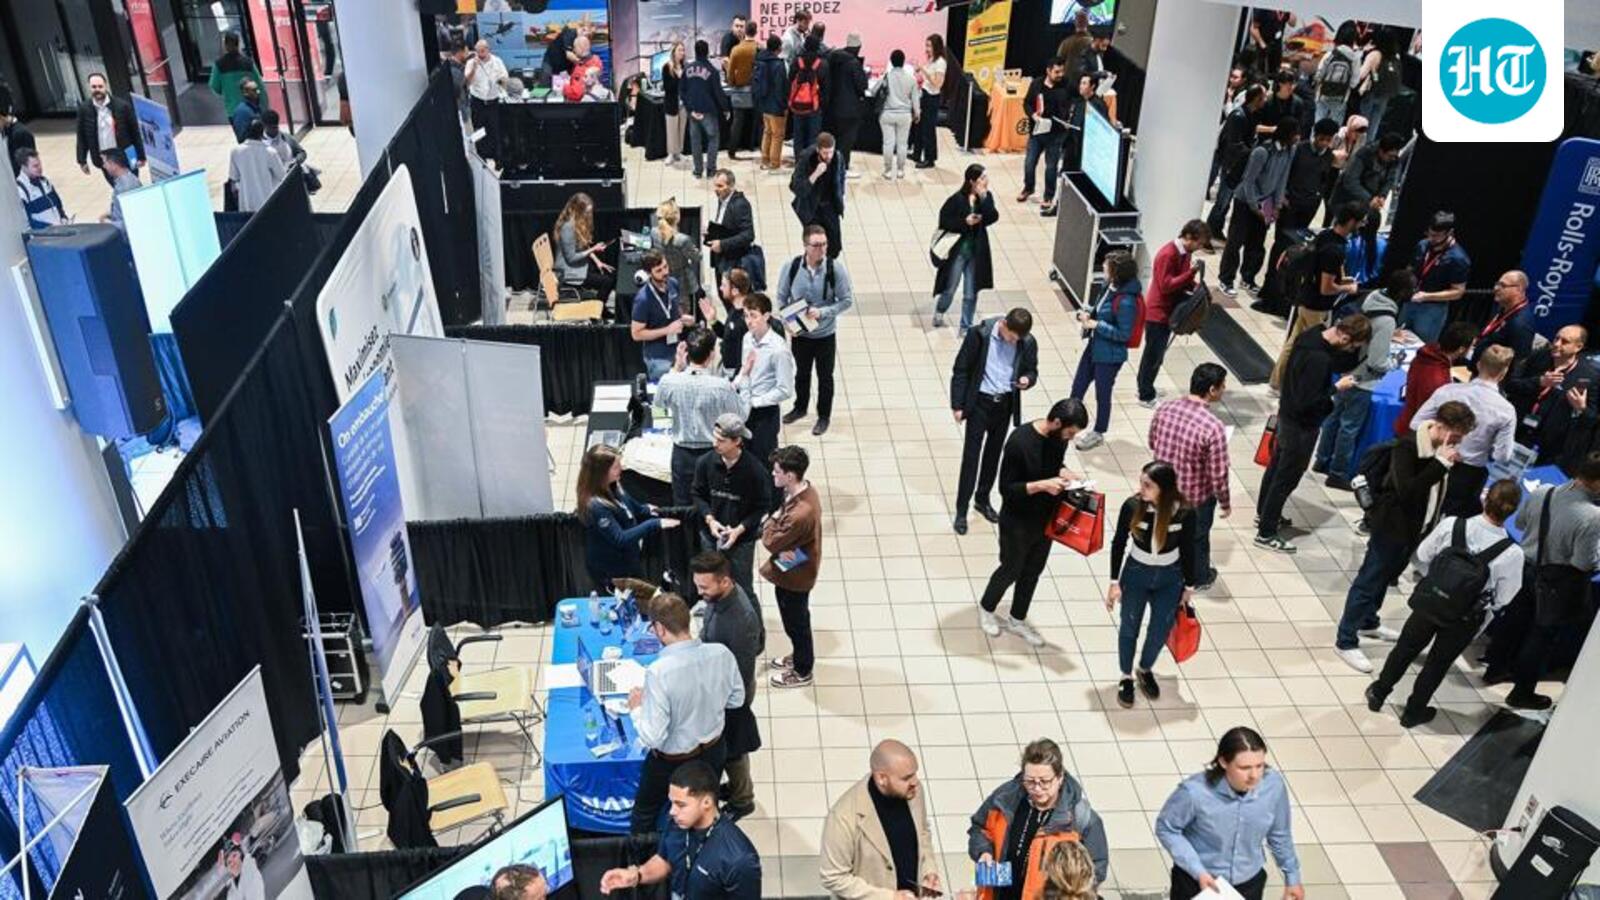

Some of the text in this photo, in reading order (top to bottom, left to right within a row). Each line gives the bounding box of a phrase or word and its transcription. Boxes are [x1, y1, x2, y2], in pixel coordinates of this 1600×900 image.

[760, 1, 841, 15] NE PERDEZ
[760, 16, 796, 28] PLUS
[1534, 202, 1595, 318] Rolls-Royce
[338, 430, 351, 448] On
[174, 748, 213, 793] EXECAIRE
[214, 710, 250, 751] AVIATION
